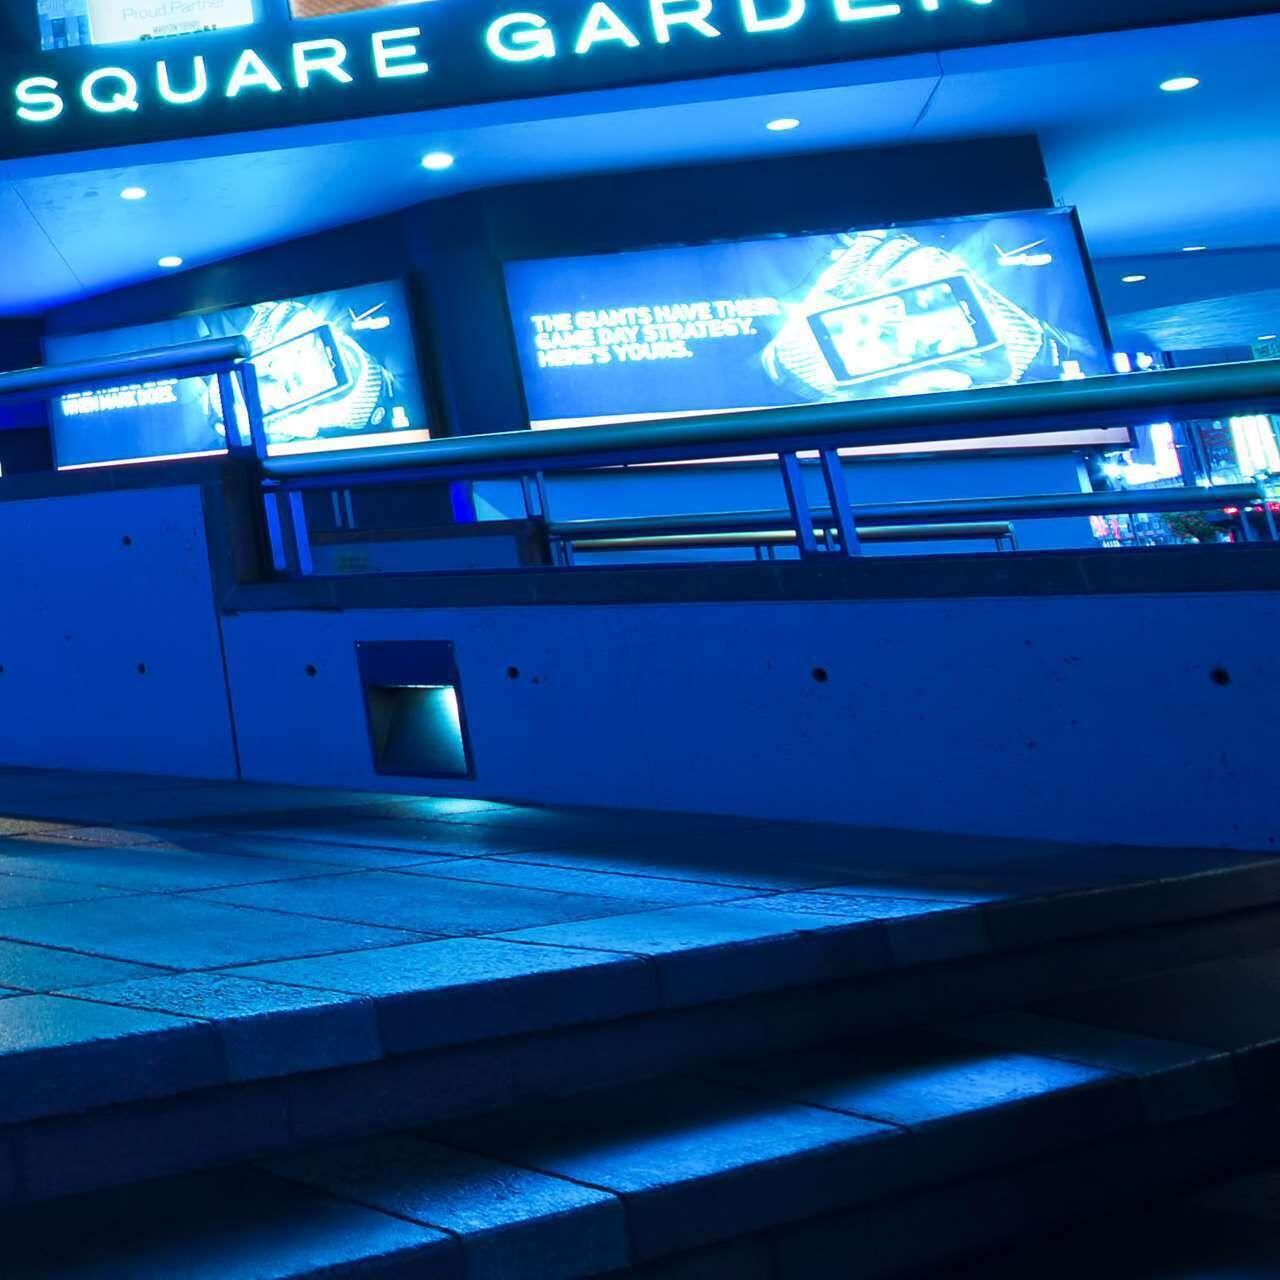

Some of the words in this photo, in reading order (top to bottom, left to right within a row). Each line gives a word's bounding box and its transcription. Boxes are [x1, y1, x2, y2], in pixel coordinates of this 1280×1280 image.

[122, 3, 167, 20] Proud
[15, 24, 429, 121] SQUARE
[530, 312, 573, 333] THE
[574, 307, 652, 329] GIANTS
[653, 301, 713, 324] HAVE
[535, 329, 596, 351] GAME
[598, 325, 641, 346] DAY
[641, 317, 758, 343] STRATEGY.
